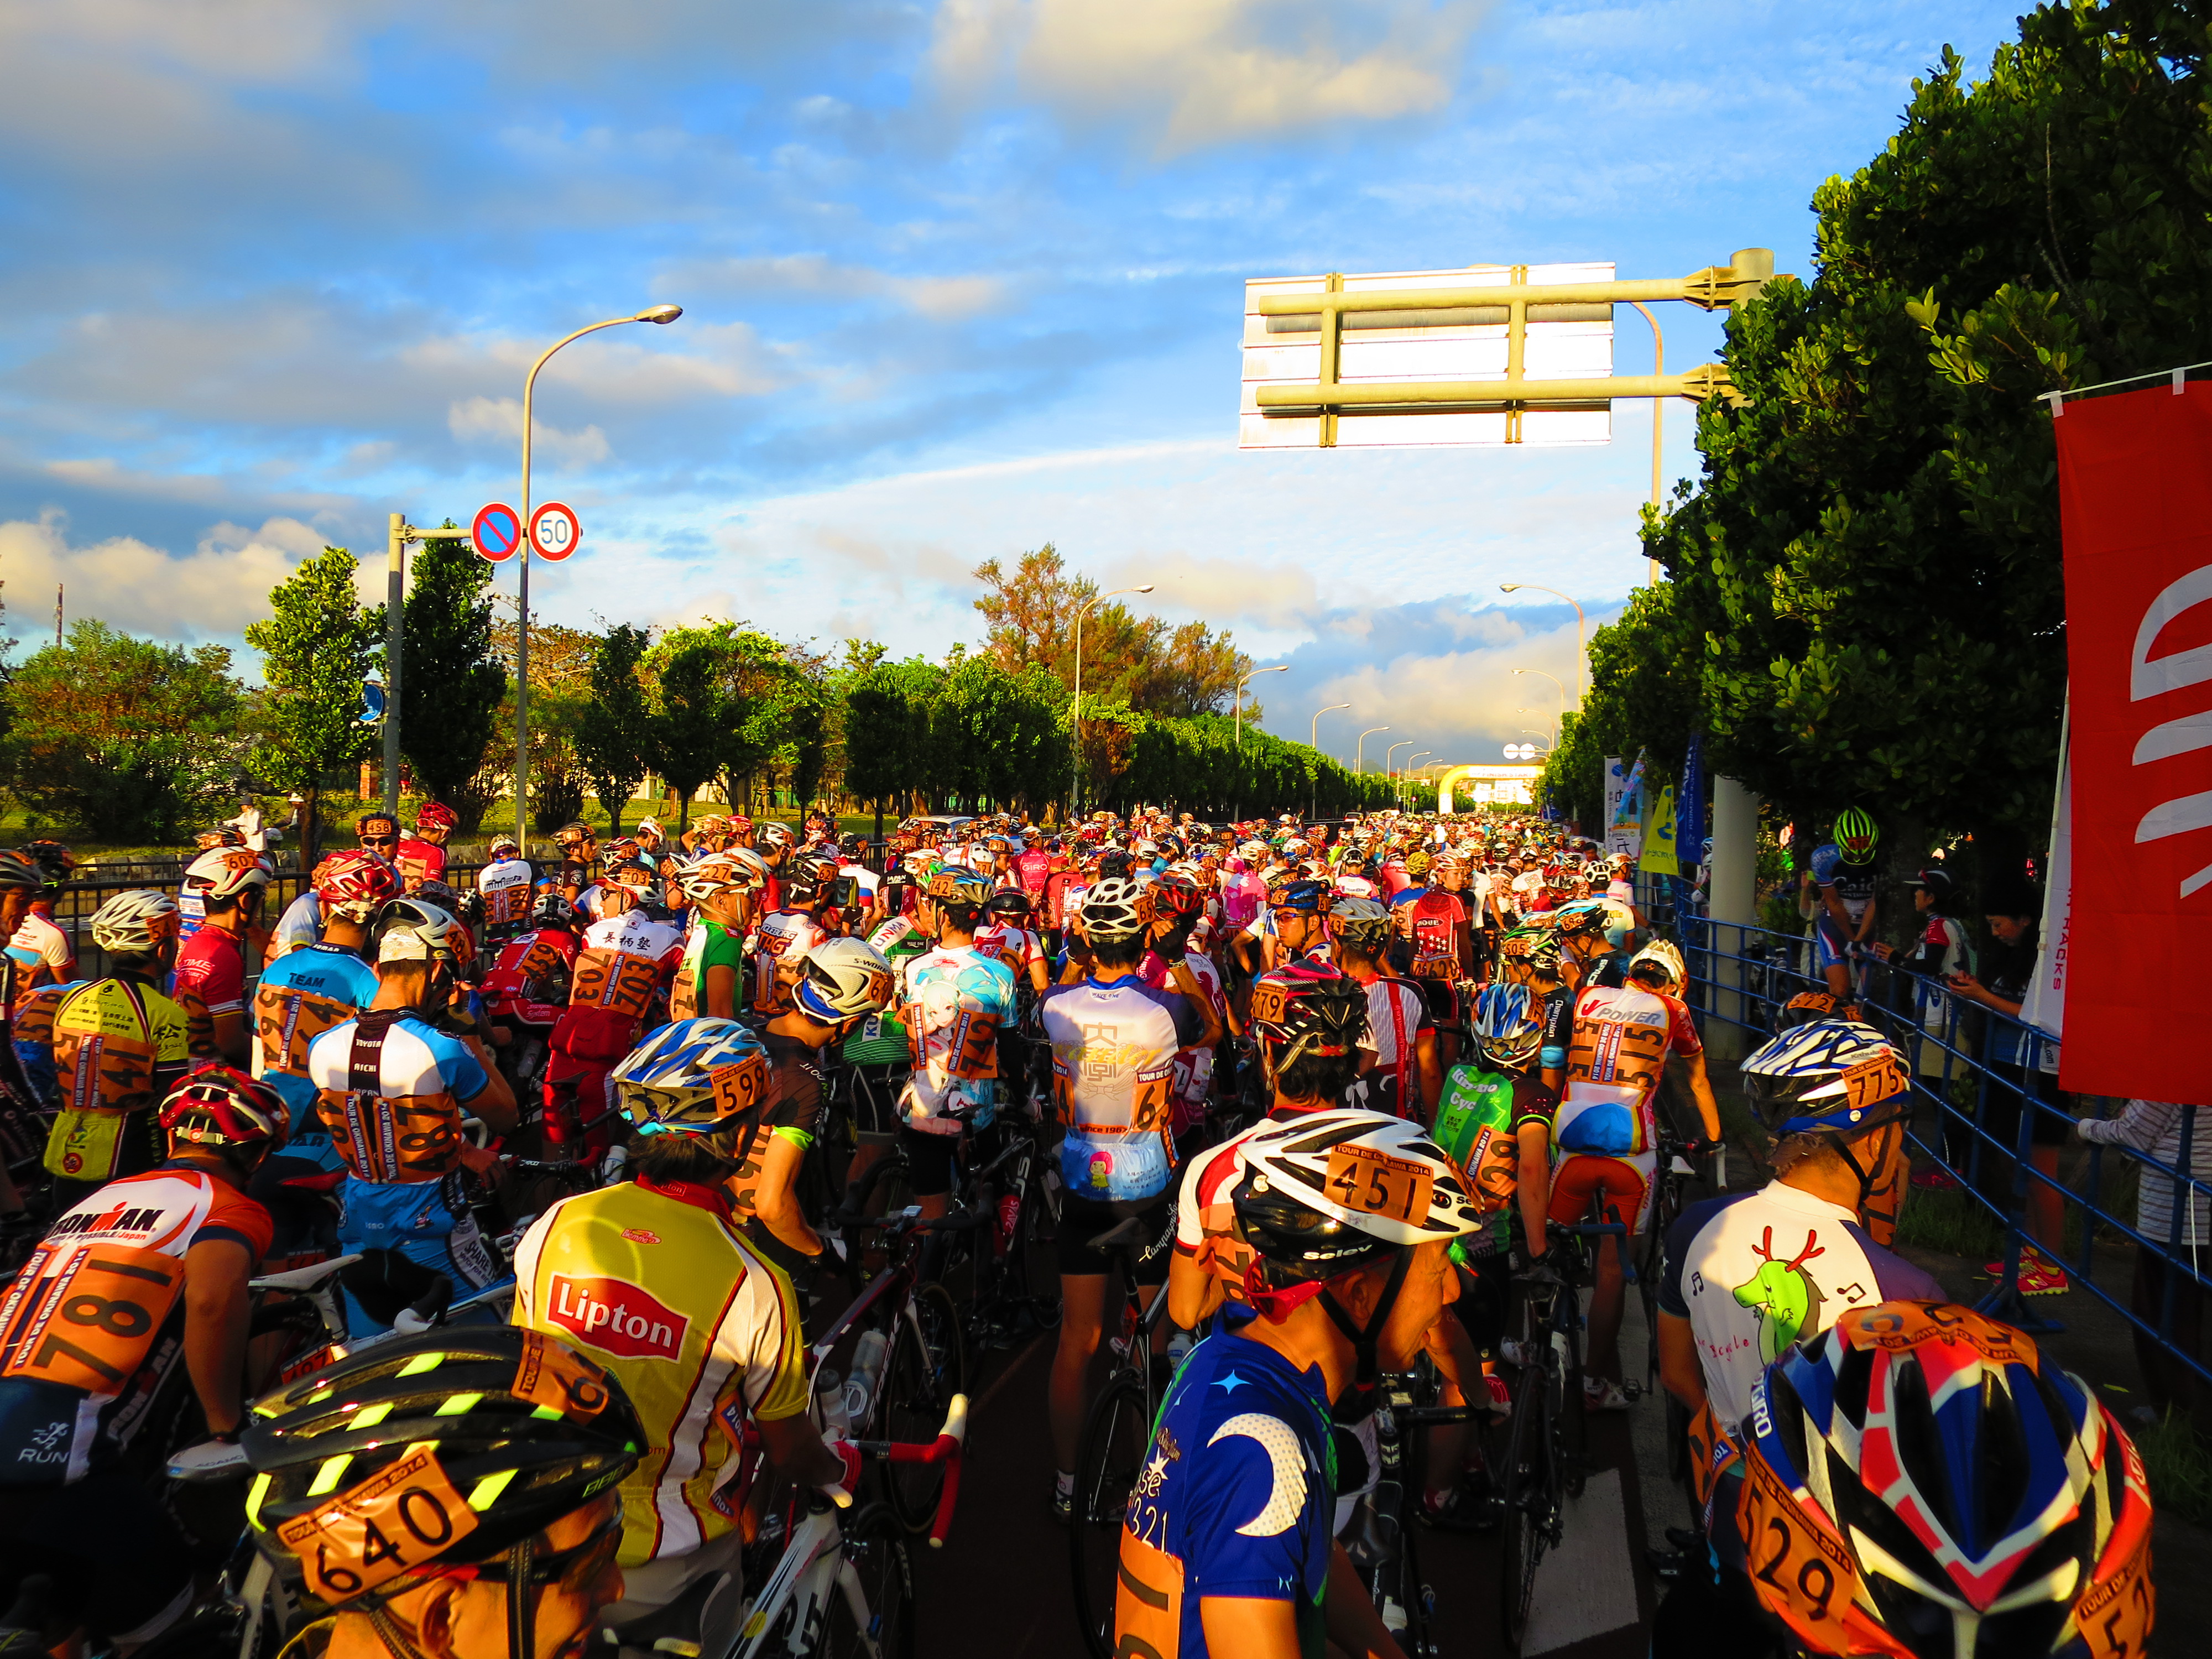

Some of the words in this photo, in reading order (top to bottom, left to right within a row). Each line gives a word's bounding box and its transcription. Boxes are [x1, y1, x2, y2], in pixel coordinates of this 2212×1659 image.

[540, 519, 568, 544] 50
[369, 823, 390, 832] 458
[886, 874, 906, 883] JAPAN
[930, 880, 950, 894] 742
[603, 931, 651, 951] 長柄塾
[762, 924, 797, 939] YCLEBORG
[525, 943, 554, 981] 459
[1506, 943, 1525, 954] 505
[289, 973, 326, 987] TEAM
[1431, 958, 1458, 979] 620
[614, 959, 659, 1011] 703
[526, 1010, 551, 1019] System
[1253, 992, 1281, 1019] 779
[1548, 999, 1564, 1037] Champion
[1597, 1007, 1661, 1025] POWER
[279, 1048, 288, 1067] TOUR
[284, 1013, 296, 1041] OKINAWA
[291, 995, 301, 1013] 2014
[356, 1039, 382, 1048] TOYOTA
[956, 1025, 967, 1047] OKINAWA
[962, 1013, 970, 1025] 2014
[959, 1019, 995, 1072] 742
[1597, 1044, 1607, 1066] OKINAWA
[1609, 1040, 1619, 1061] OKINAWA
[1615, 1027, 1665, 1088] 515
[76, 1062, 87, 1093] OKINAWA
[354, 1063, 377, 1072] AICHI
[713, 1073, 727, 1083] TOUR
[1139, 1071, 1155, 1082] TOUR
[1156, 1070, 1164, 1079] DE
[1592, 1066, 1601, 1080] 2014
[1844, 1068, 1858, 1076] TOUR
[721, 1064, 765, 1112] 599
[1851, 1066, 1899, 1105] 775
[353, 1127, 367, 1159] OKINAWA
[382, 1121, 394, 1152] OKINAWA
[1105, 1126, 1127, 1134] 1967
[1337, 1145, 1360, 1156] TOUR
[1361, 1150, 1374, 1159] DE
[1408, 1165, 1430, 1176] 2014
[1469, 1146, 1484, 1178] OKINAWA
[1479, 1131, 1490, 1146] 2014
[1332, 1162, 1417, 1220] 451
[25, 1251, 48, 1276] TOUR
[1302, 1244, 1373, 1260] Selev
[14, 1335, 35, 1366] TOUR
[39, 1276, 71, 1321] OKINAWA
[67, 1250, 88, 1276] 2014
[32, 1259, 173, 1382] 781
[557, 1282, 673, 1348] Lipton
[521, 1365, 540, 1392] TOUR
[18, 1448, 69, 1464] RUN
[389, 1454, 428, 1484] 2014
[582, 1464, 626, 1498] BBB
[317, 1486, 452, 1593] 640
[1818, 1531, 1851, 1571] 2014
[2080, 1585, 2111, 1618] TOUR
